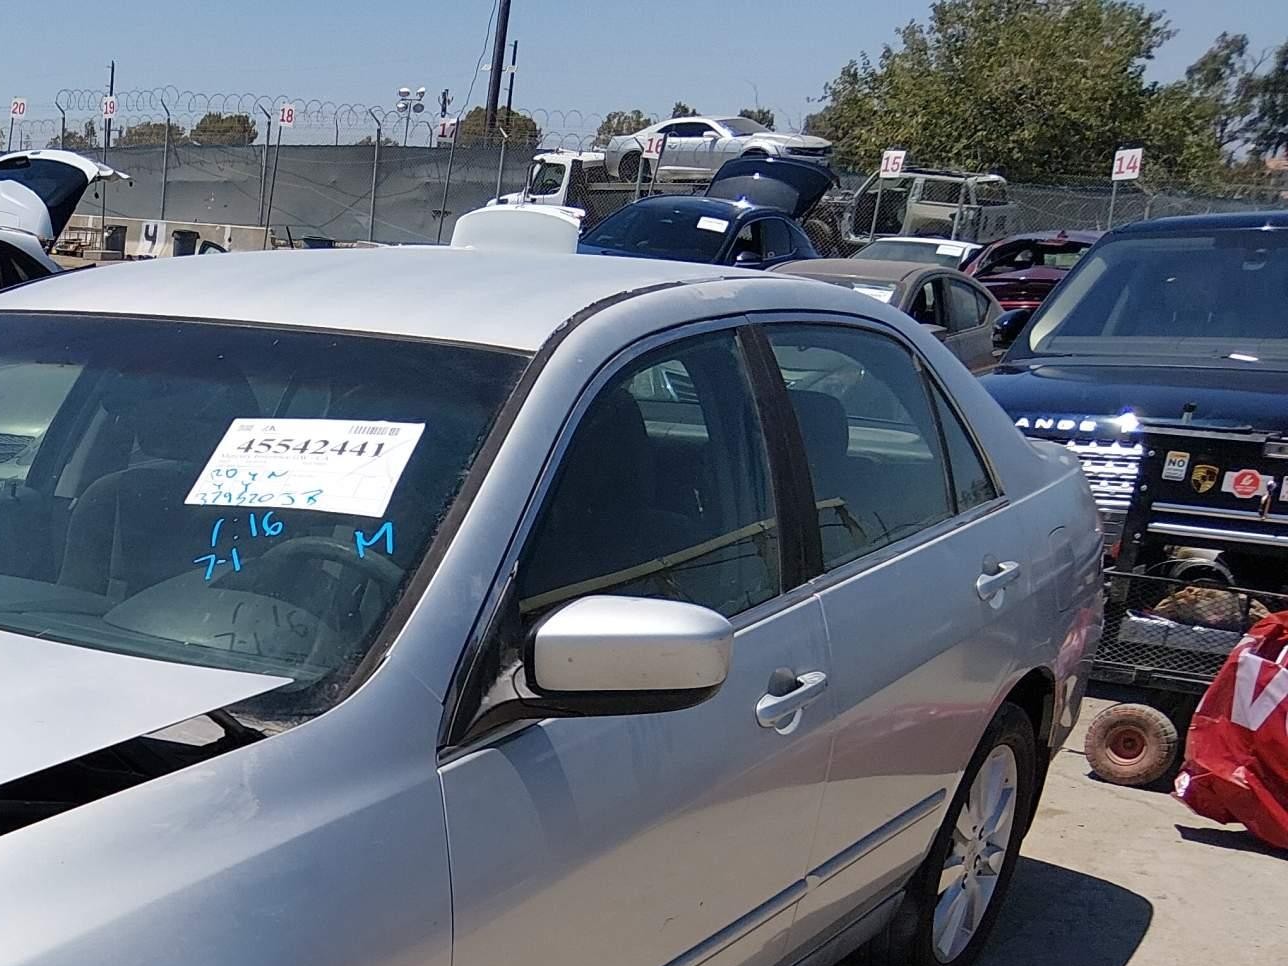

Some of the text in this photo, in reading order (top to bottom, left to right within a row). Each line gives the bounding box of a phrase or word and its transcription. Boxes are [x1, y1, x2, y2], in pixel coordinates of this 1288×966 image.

[11, 101, 25, 115] 20
[103, 100, 115, 114] 19
[279, 107, 294, 123] 18
[438, 122, 457, 138] 17
[645, 137, 664, 154] 16
[881, 155, 902, 173] 15
[1114, 154, 1138, 175] 14
[143, 223, 158, 251] 4
[237, 438, 385, 458] 45542441
[1167, 458, 1186, 468] NO
[211, 511, 393, 558] 1:16 M
[193, 547, 241, 581] 7-1
